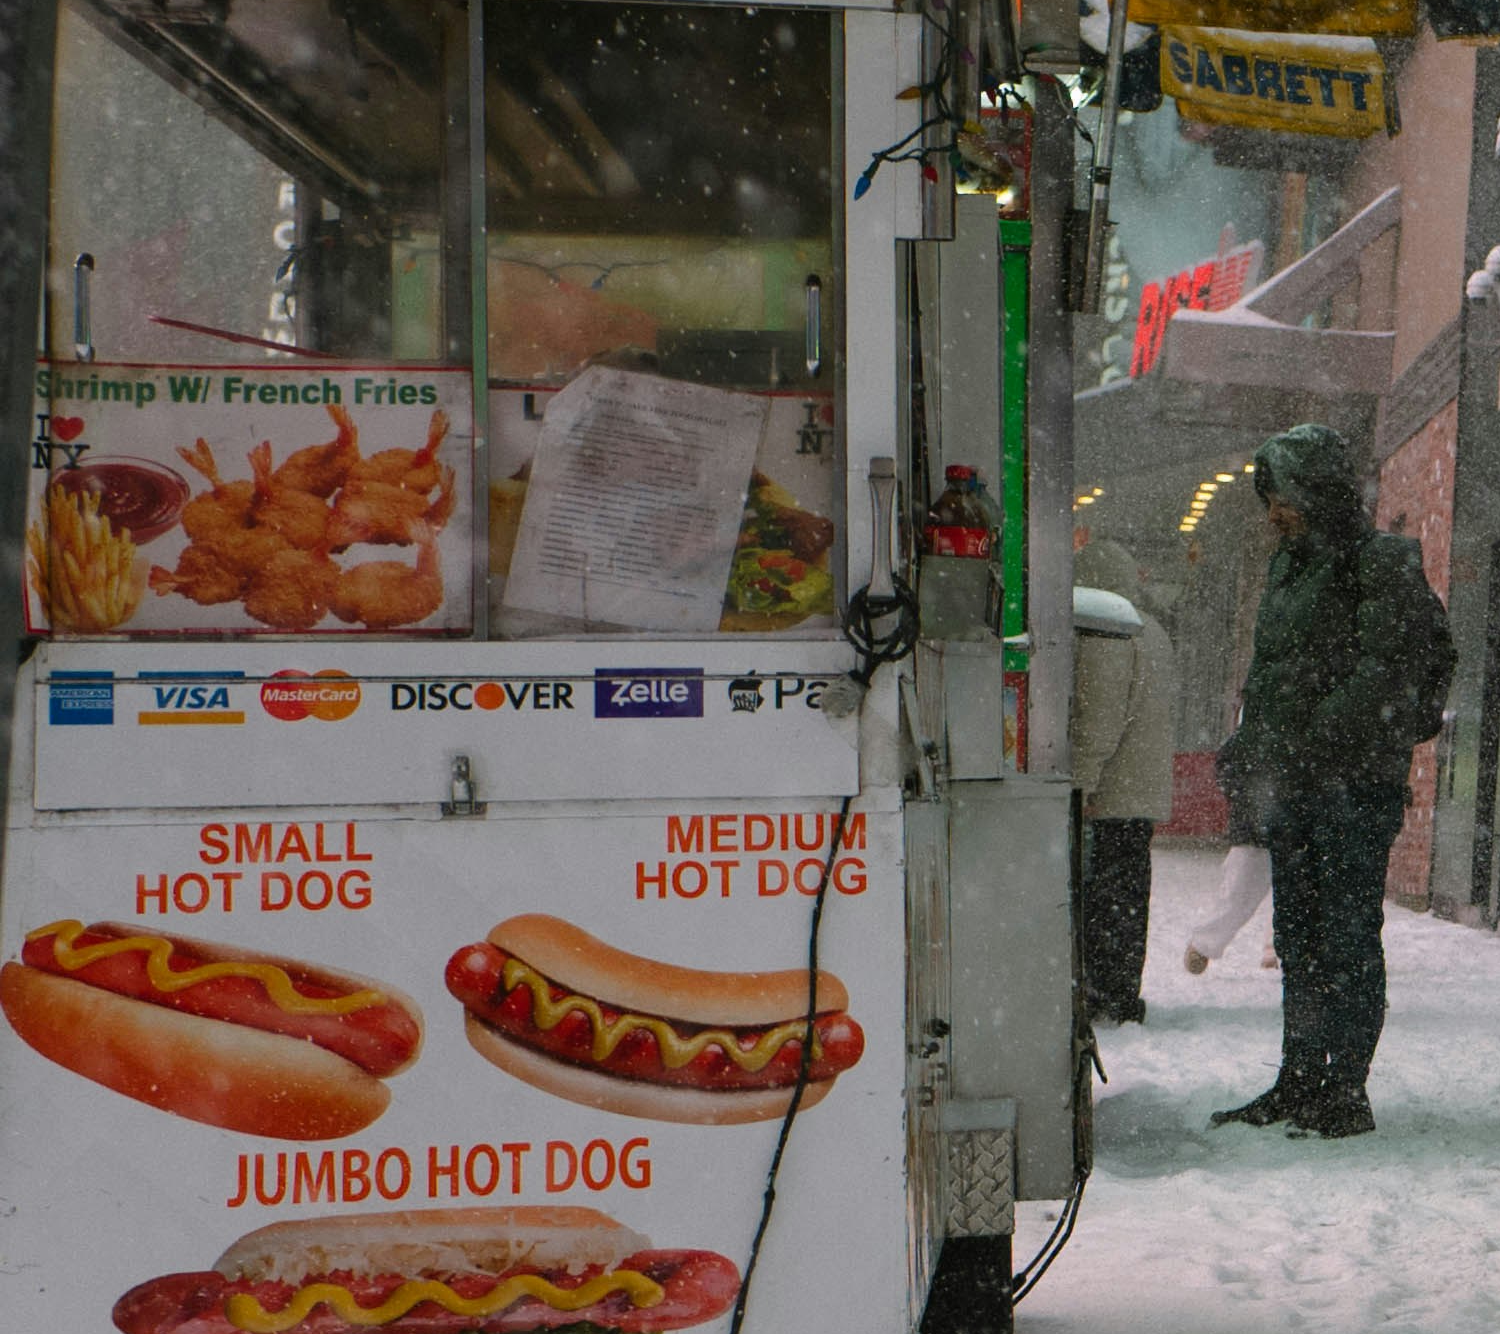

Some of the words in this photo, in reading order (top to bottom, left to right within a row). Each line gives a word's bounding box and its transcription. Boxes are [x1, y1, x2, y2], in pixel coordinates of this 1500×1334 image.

[1169, 43, 1372, 112] SABRETT
[35, 373, 157, 408] Shrimp
[168, 376, 211, 404] W/
[223, 376, 342, 405] French
[353, 378, 438, 405] Fries
[36, 415, 51, 442] I
[32, 443, 90, 470] NY
[50, 688, 110, 699] AMERICAN
[62, 699, 115, 710] EXPRESS
[153, 687, 231, 709] VISA
[263, 687, 360, 703] MasterCard
[390, 682, 575, 711] DISCOVER
[610, 678, 691, 707] Zelle
[775, 671, 828, 710] Pa
[198, 822, 374, 864] SMALL
[666, 812, 867, 854] MEDIUM
[134, 871, 242, 915] HOT
[260, 869, 373, 914] DOG
[635, 859, 741, 900] HOT
[756, 856, 869, 898] DOG
[226, 1147, 411, 1208] JUMBO
[427, 1142, 531, 1199] HOT
[544, 1137, 652, 1194] DOG
